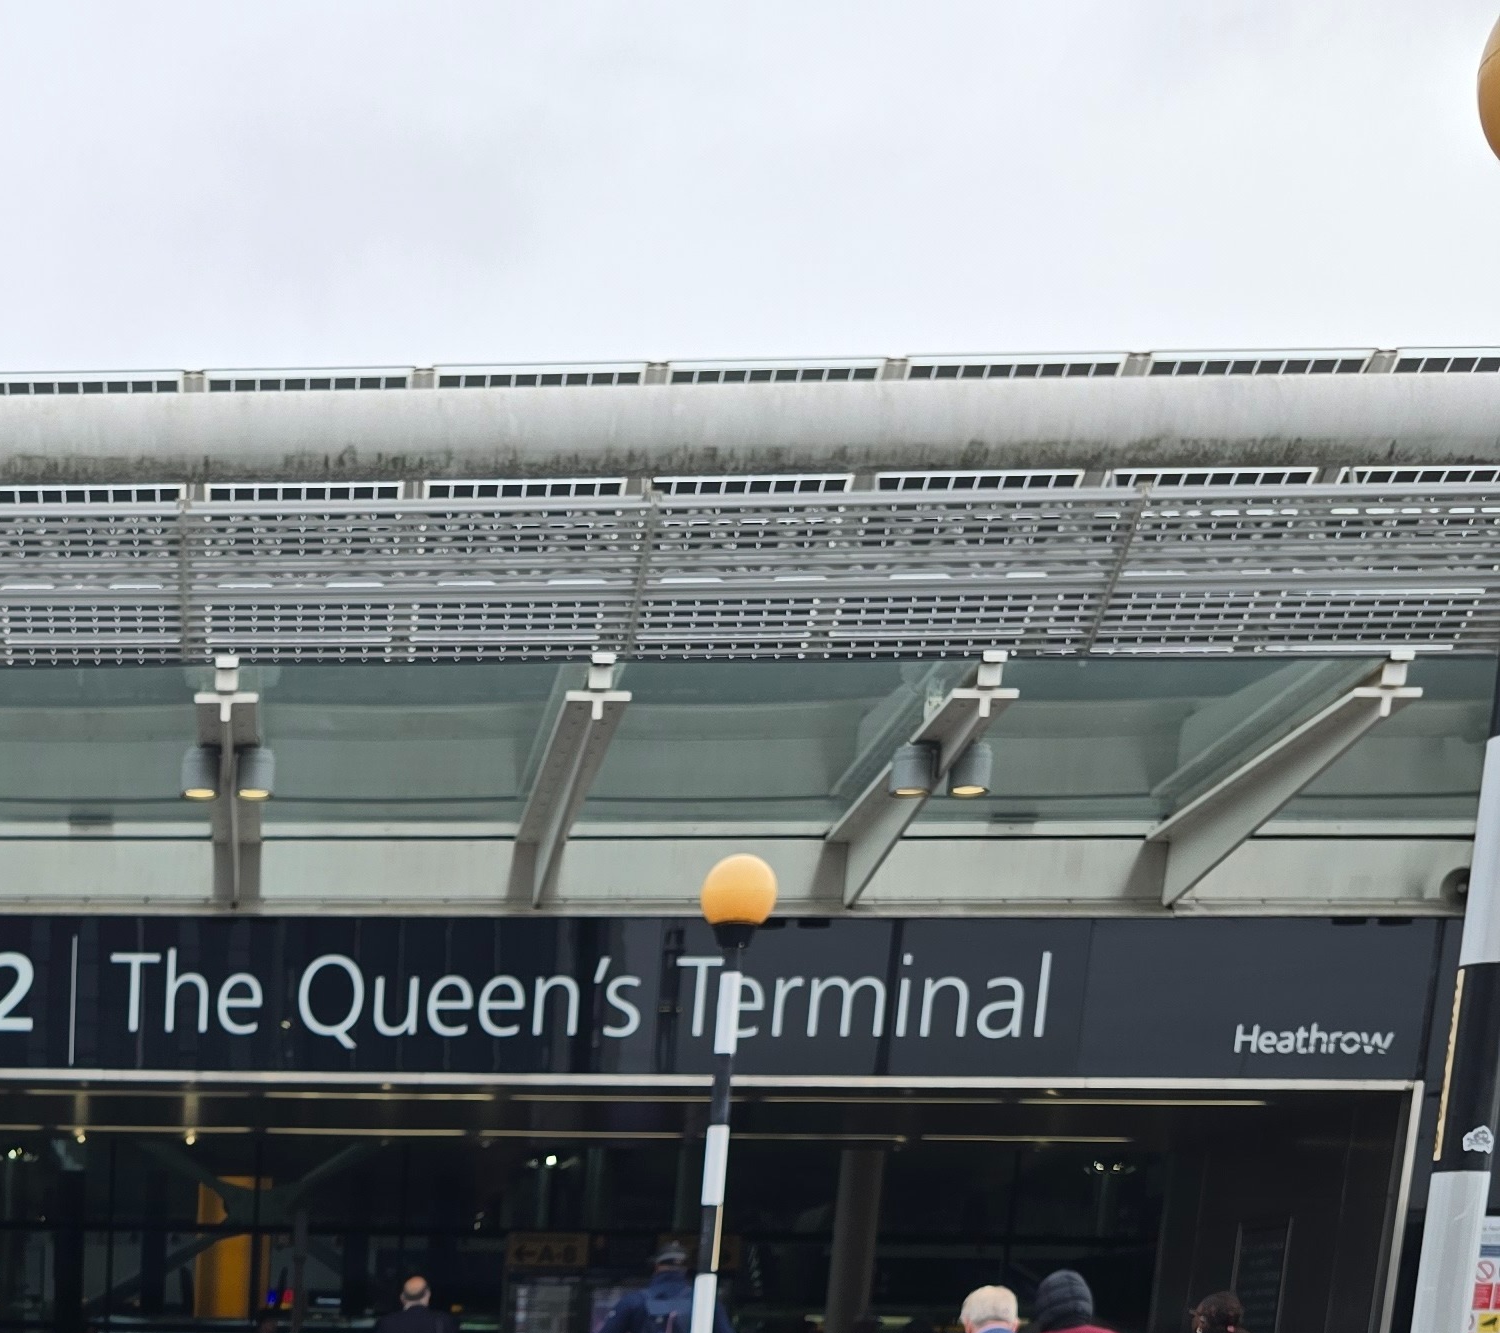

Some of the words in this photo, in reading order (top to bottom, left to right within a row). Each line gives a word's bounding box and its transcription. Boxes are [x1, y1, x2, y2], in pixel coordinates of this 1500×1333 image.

[110, 947, 263, 1035] The
[298, 953, 642, 1050] Queen's
[676, 950, 1052, 1039] Terminal
[1233, 1022, 1395, 1055] Heathrow
